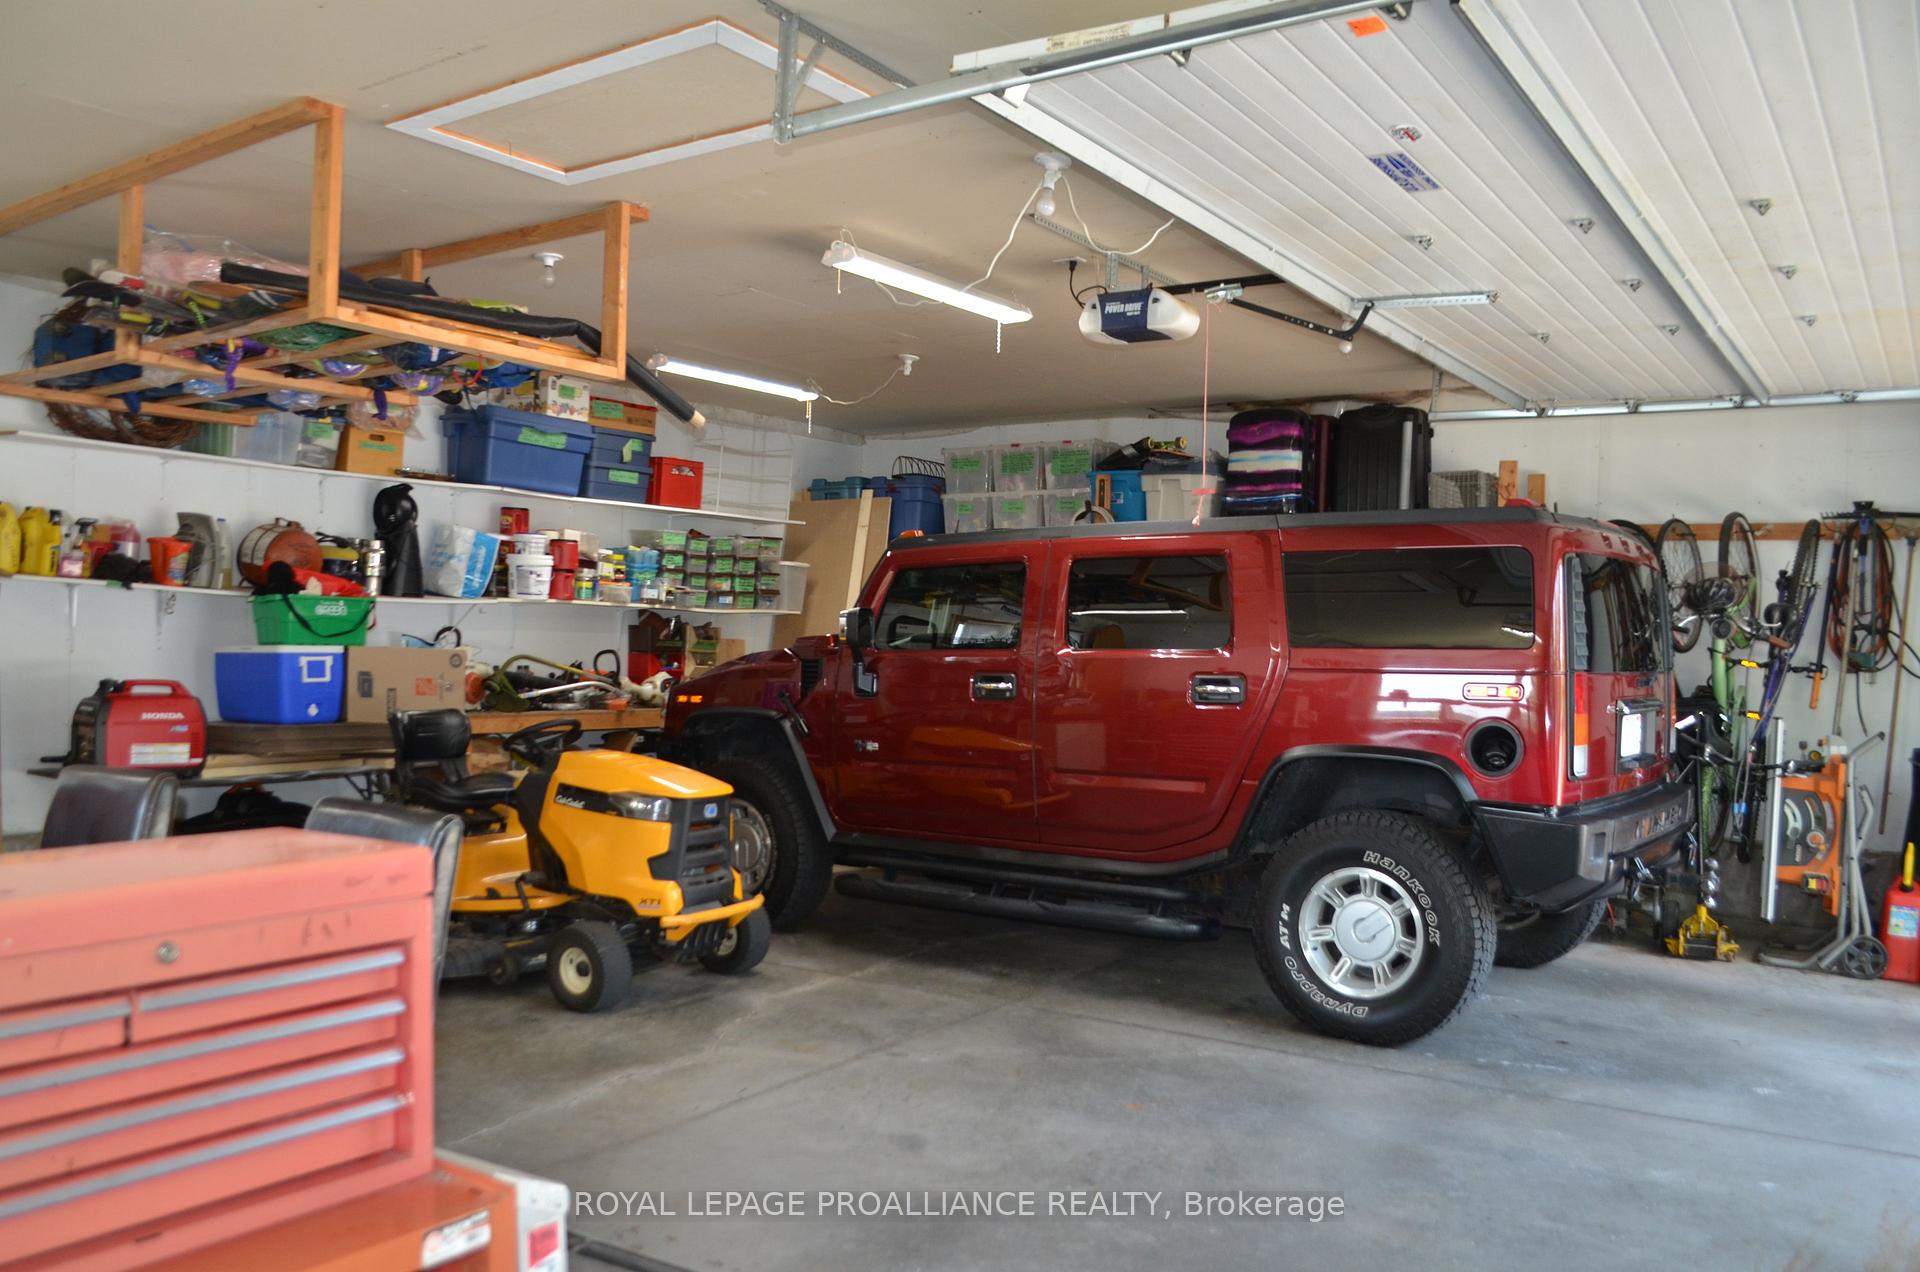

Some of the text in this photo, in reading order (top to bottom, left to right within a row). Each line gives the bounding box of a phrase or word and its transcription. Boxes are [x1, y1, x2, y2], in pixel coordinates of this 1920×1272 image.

[1104, 304, 1124, 314] POWER
[1125, 302, 1142, 312] DRIVE
[141, 712, 185, 720] HONDA
